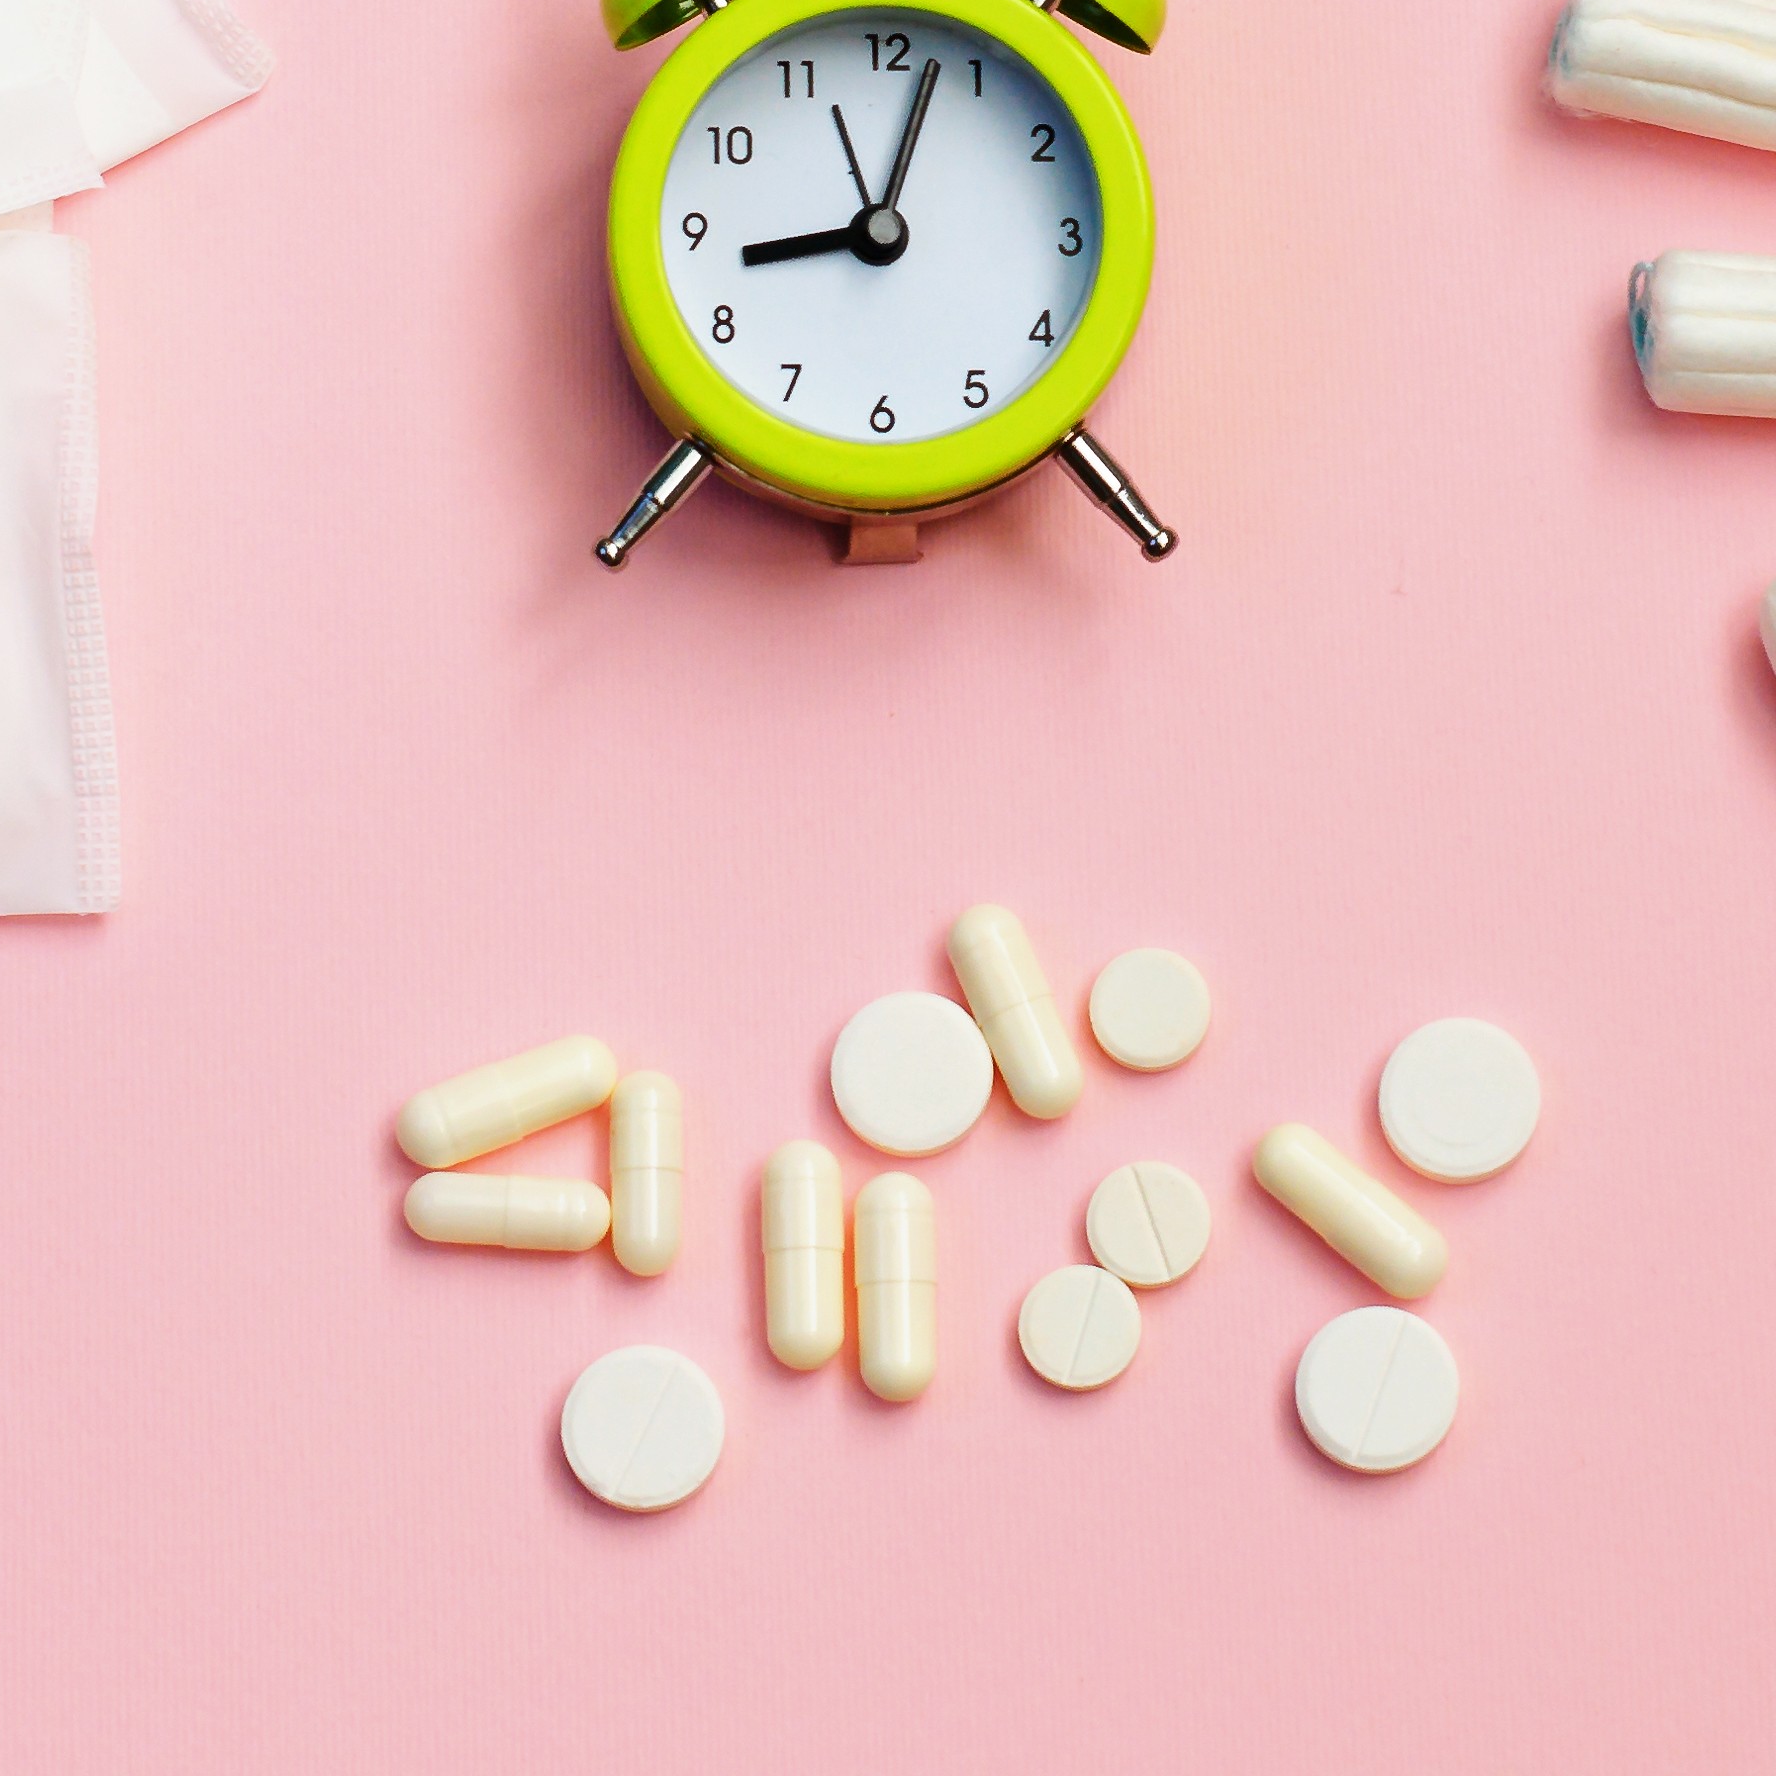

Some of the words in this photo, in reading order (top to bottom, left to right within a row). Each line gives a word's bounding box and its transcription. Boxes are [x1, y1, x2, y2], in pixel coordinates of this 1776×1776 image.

[864, 33, 910, 71] 12
[777, 61, 813, 98] 11
[968, 60, 982, 97] 1
[707, 126, 752, 164] 10
[1031, 124, 1055, 162] 2
[683, 213, 707, 251] 9
[1059, 218, 1083, 256] 3
[713, 305, 734, 344] 8
[1029, 310, 1054, 347] 4
[781, 364, 802, 401] 7
[964, 370, 989, 408] 5
[870, 396, 895, 433] 6
